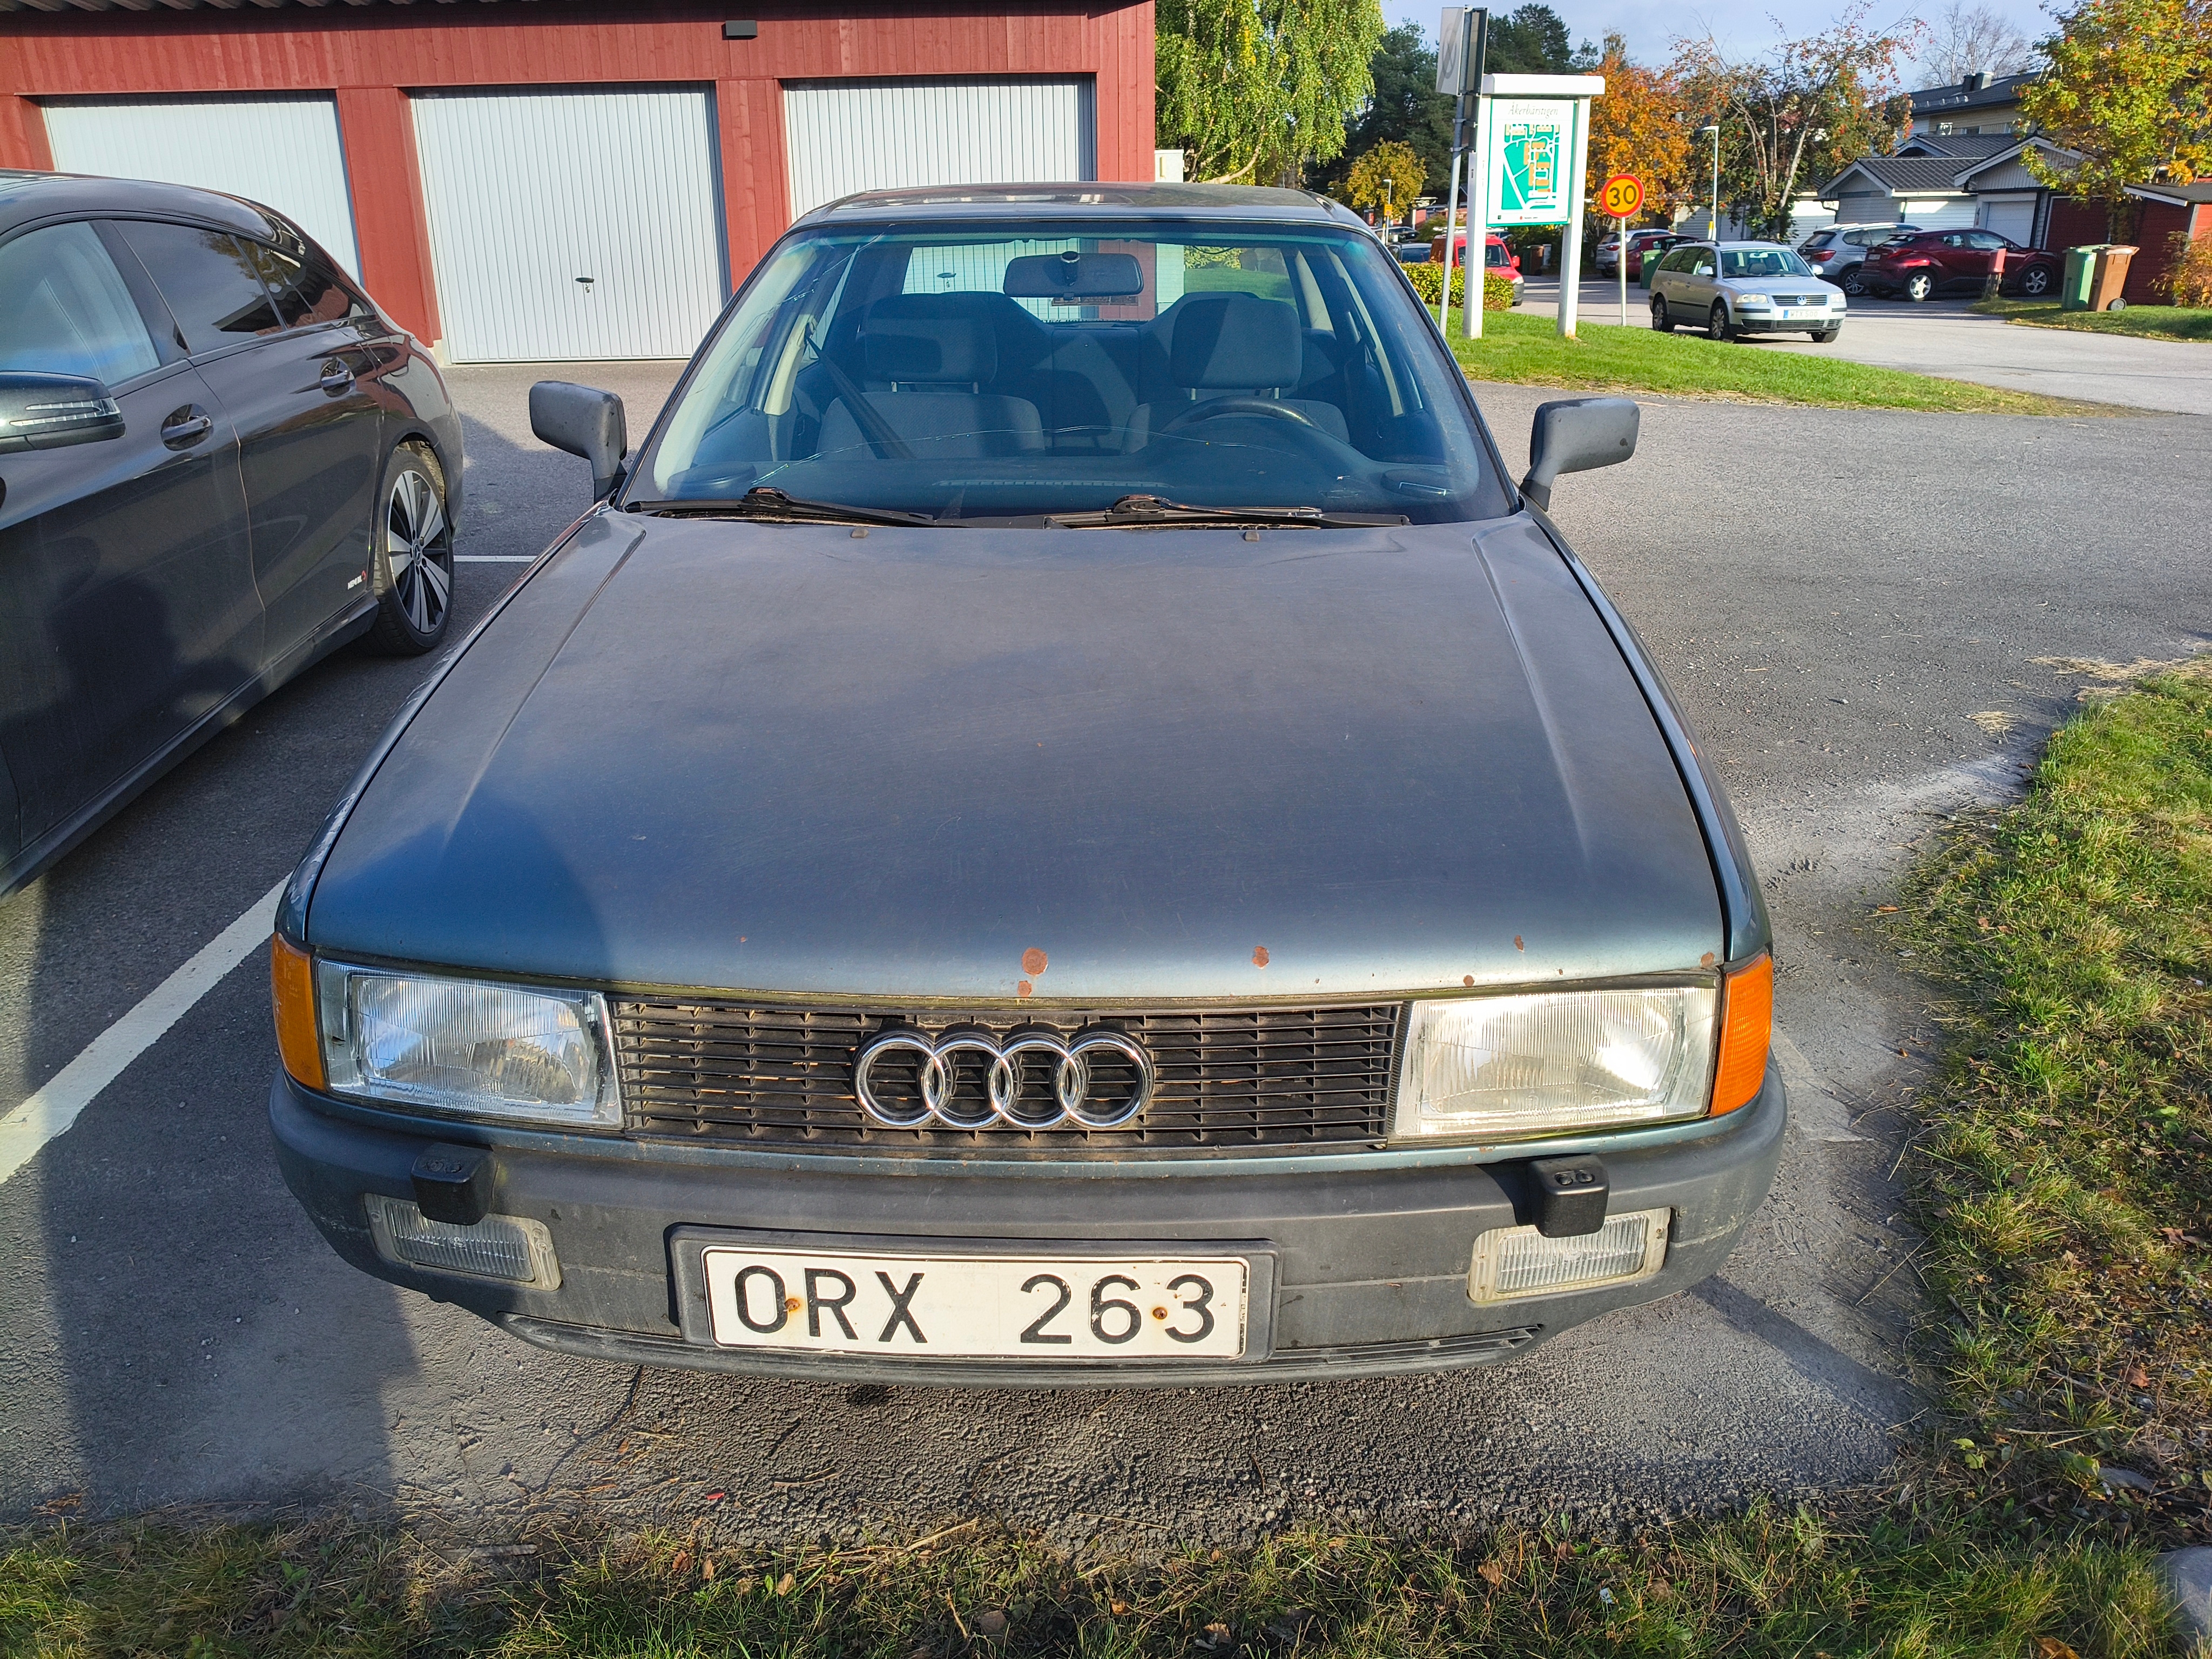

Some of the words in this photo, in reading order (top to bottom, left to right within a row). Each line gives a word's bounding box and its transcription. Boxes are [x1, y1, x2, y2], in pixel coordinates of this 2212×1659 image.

[1609, 185, 1637, 207] 30
[734, 1265, 928, 1344] ORX
[1020, 1274, 1215, 1344] 263
